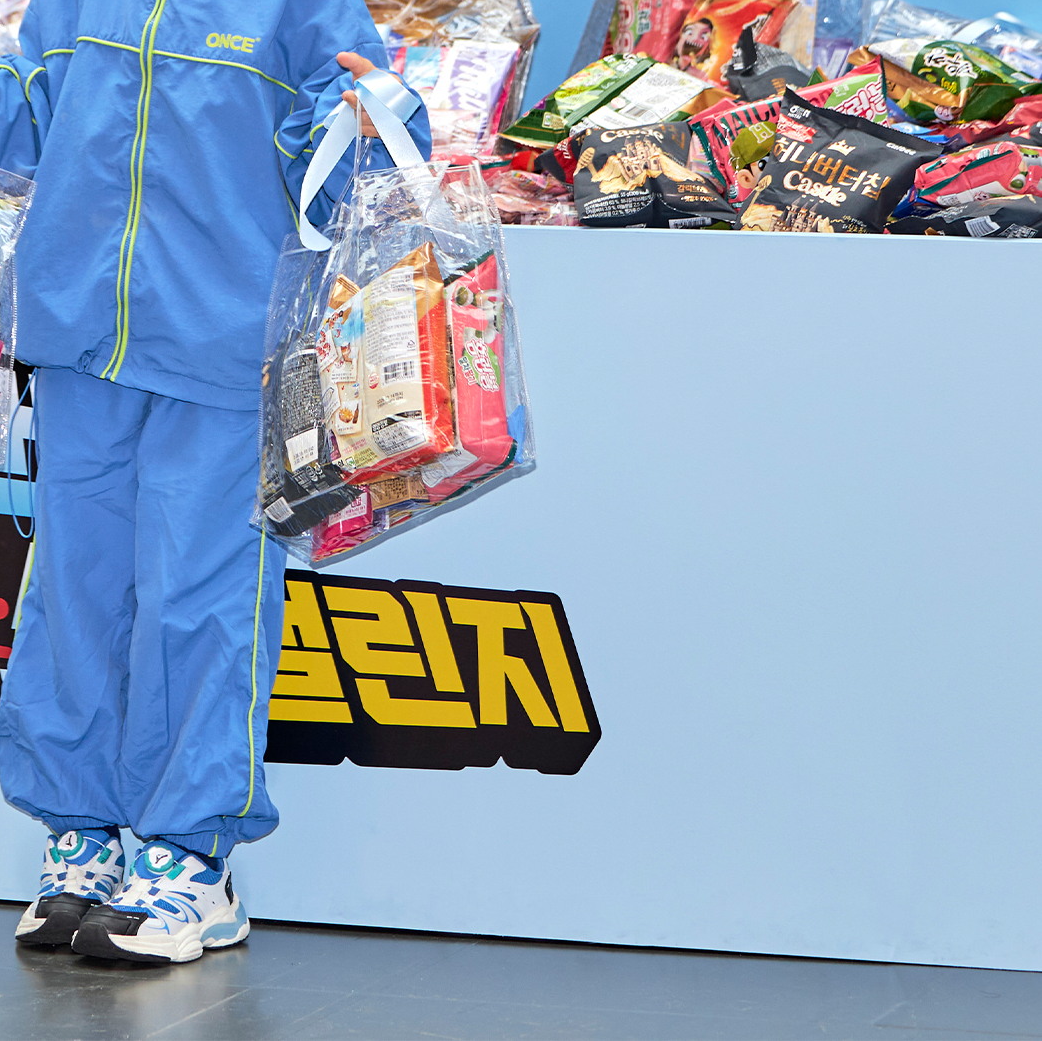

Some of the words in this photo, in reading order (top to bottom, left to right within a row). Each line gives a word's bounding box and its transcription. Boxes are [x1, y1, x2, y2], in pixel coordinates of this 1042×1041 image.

[205, 32, 256, 54] ONCE
[828, 74, 886, 125] 런볼
[774, 136, 892, 202] 허니버터칩
[783, 169, 848, 207] Castle
